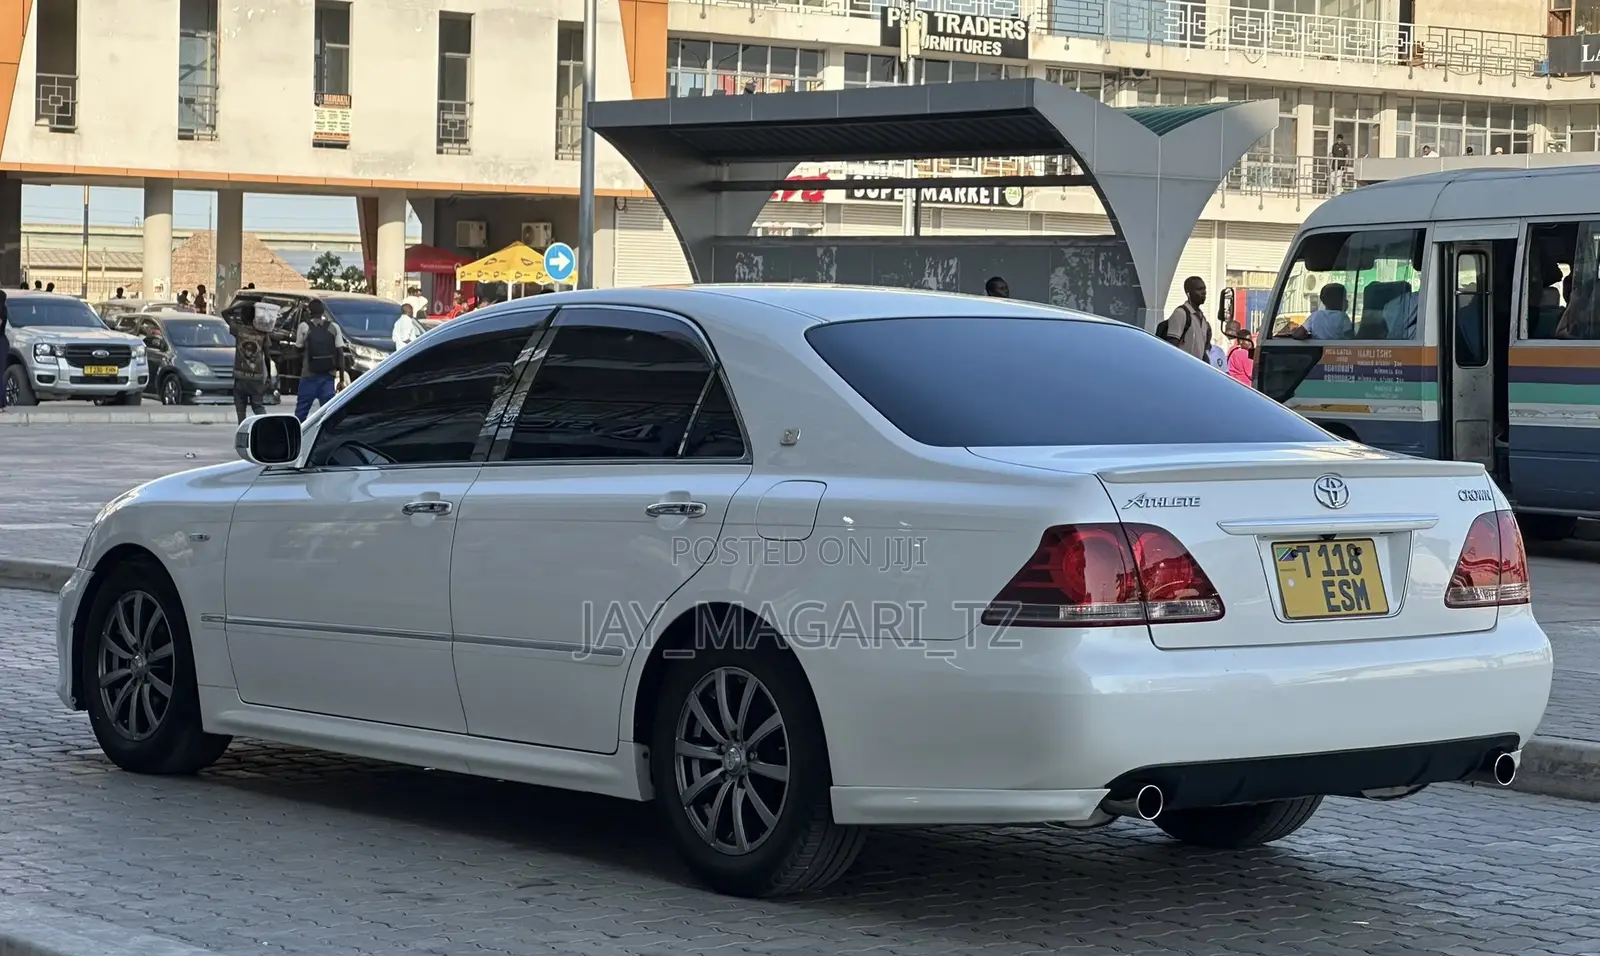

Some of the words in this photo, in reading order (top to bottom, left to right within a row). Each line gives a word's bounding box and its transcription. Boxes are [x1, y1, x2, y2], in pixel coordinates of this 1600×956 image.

[934, 12, 1026, 40] TRADERS
[921, 34, 1002, 56] URNITURES
[1121, 492, 1201, 510] ATHLETE
[1458, 489, 1492, 502] CROWN
[1296, 545, 1312, 578] T
[1317, 543, 1363, 577] 118
[1321, 578, 1371, 613] ESM
